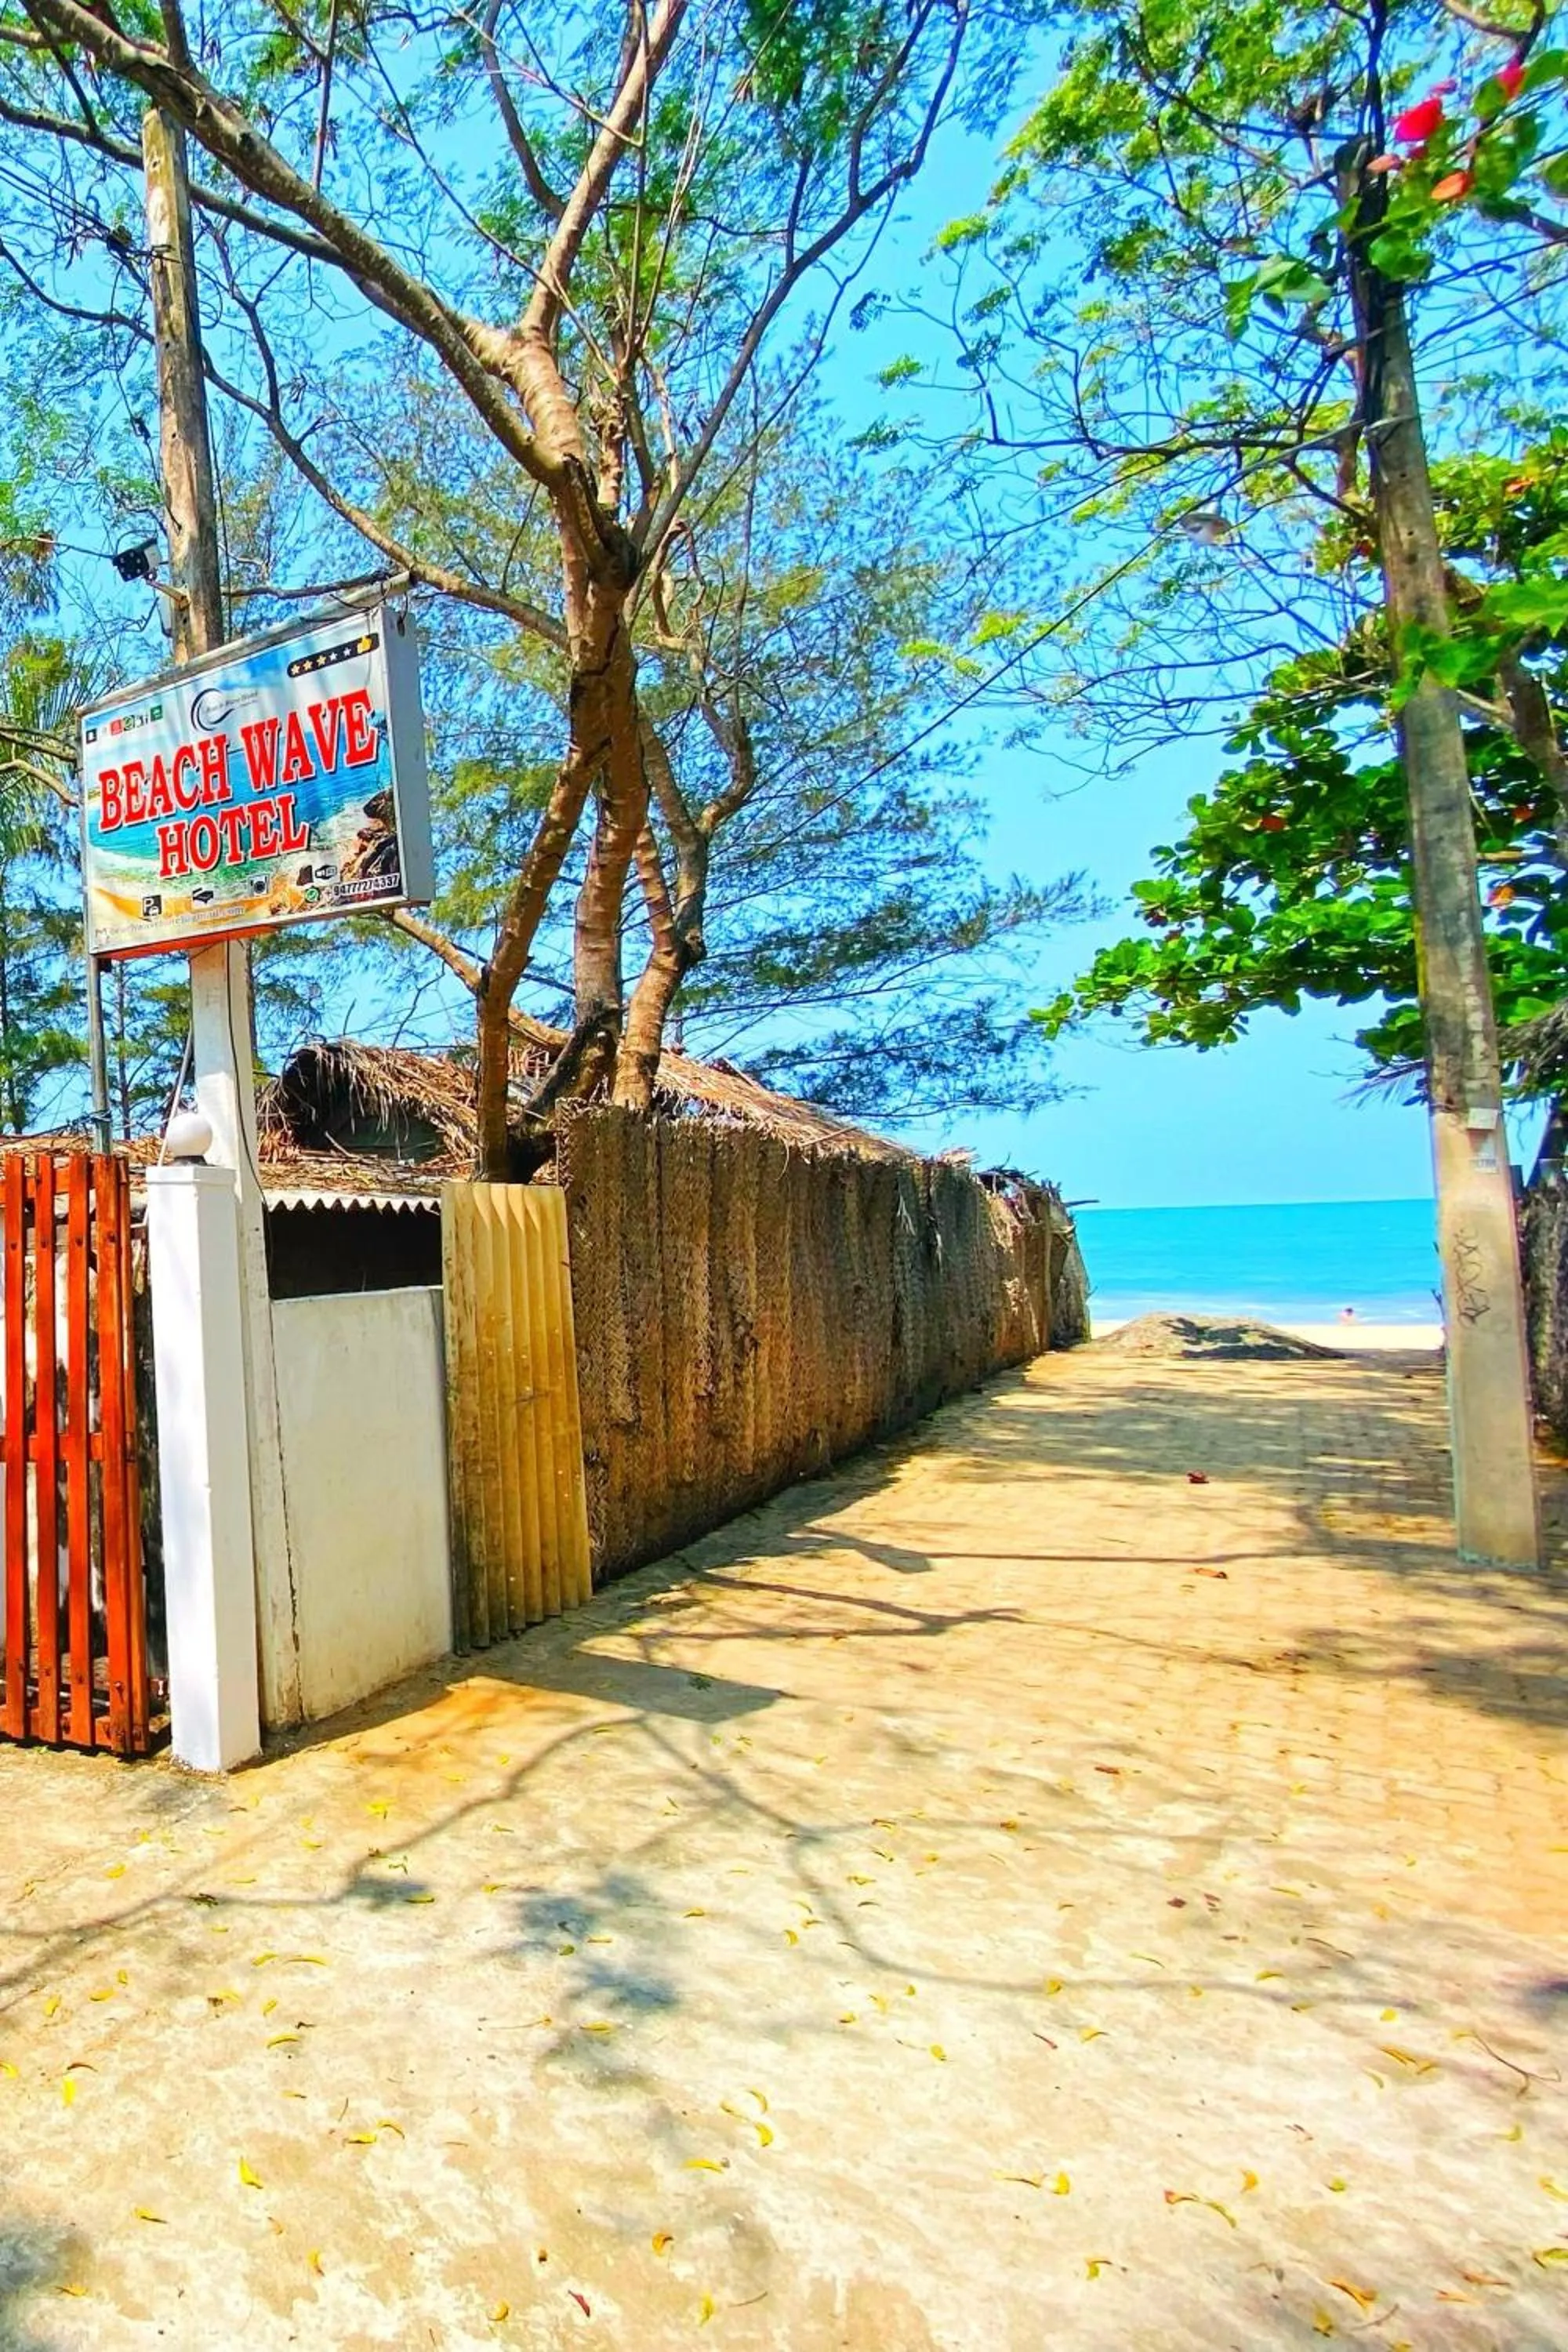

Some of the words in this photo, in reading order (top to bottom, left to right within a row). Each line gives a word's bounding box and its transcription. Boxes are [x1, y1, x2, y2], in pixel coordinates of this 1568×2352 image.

[99, 733, 233, 831] BEACH
[240, 688, 377, 793] WAVE
[157, 793, 310, 879] HOTEL
